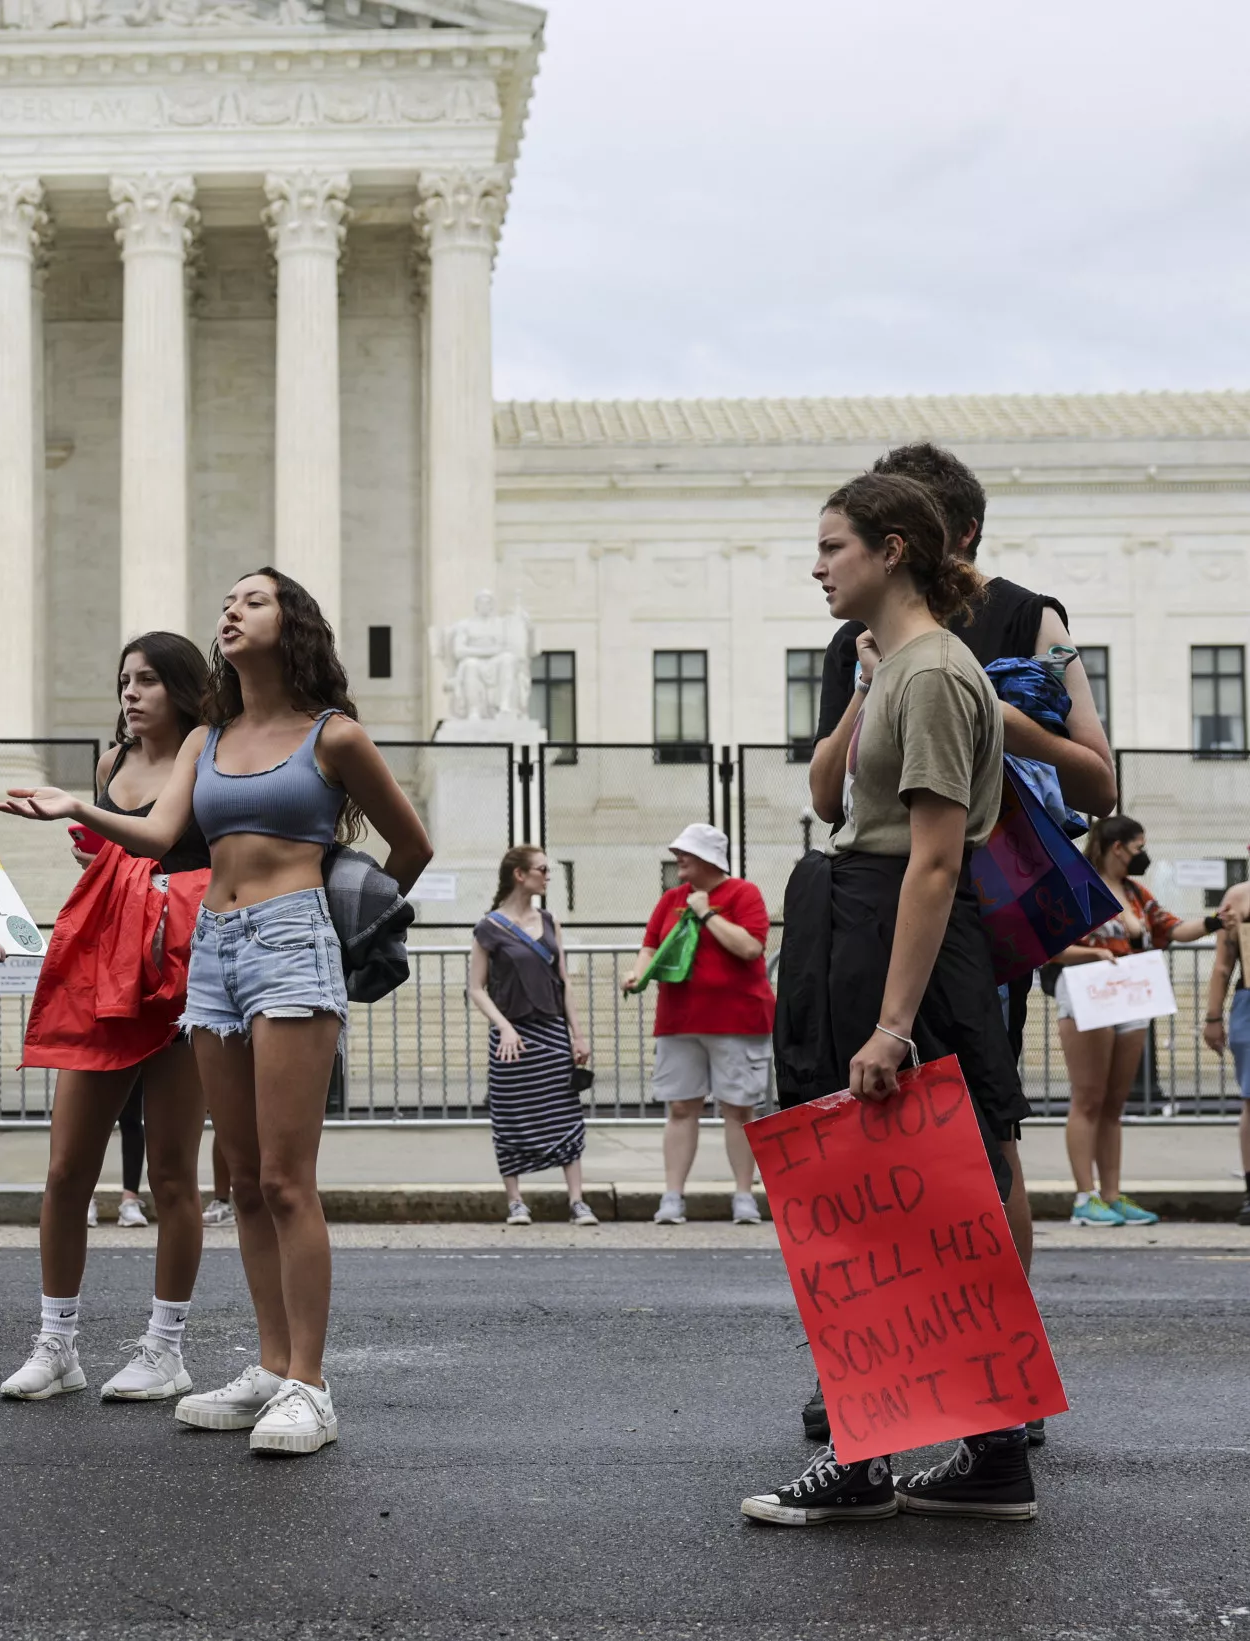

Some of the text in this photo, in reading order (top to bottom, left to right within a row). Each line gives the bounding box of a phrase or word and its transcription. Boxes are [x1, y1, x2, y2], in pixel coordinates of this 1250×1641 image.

[73, 98, 131, 122] LAW
[759, 1074, 966, 1175] IF GOD
[782, 1164, 926, 1246] COULD
[800, 1211, 1002, 1315] KILL HIS
[837, 1369, 948, 1443] CAN'T
